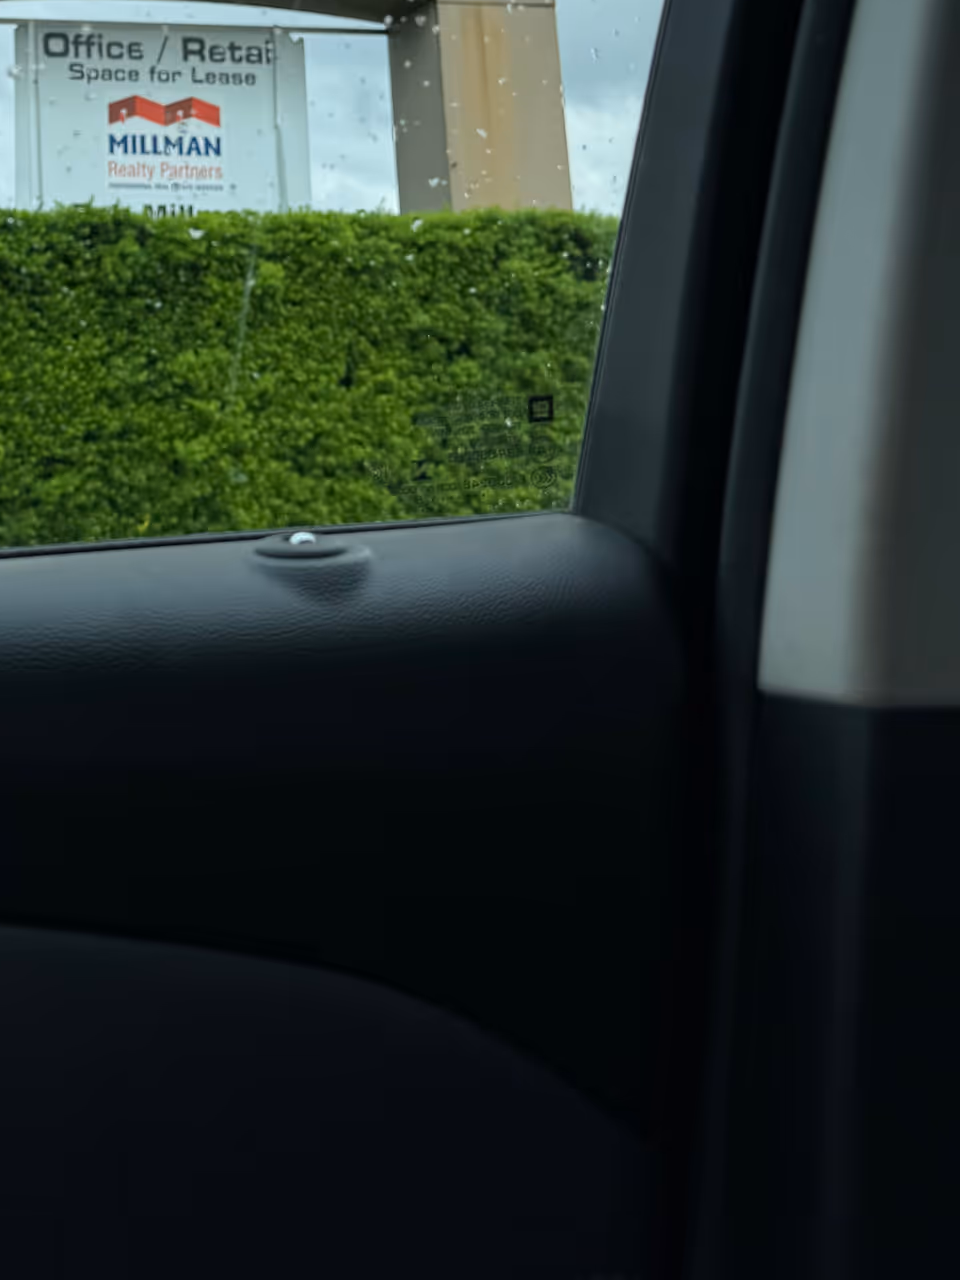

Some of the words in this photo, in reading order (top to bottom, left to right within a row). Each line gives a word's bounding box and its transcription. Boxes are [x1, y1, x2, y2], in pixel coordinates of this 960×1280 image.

[42, 32, 144, 60] Office
[182, 36, 274, 65] Retai
[68, 63, 139, 84] Space
[150, 65, 182, 83] for
[192, 67, 257, 86] Lease
[108, 134, 221, 156] MILLMAN
[108, 161, 155, 180] Realty
[160, 161, 223, 180] Partners
